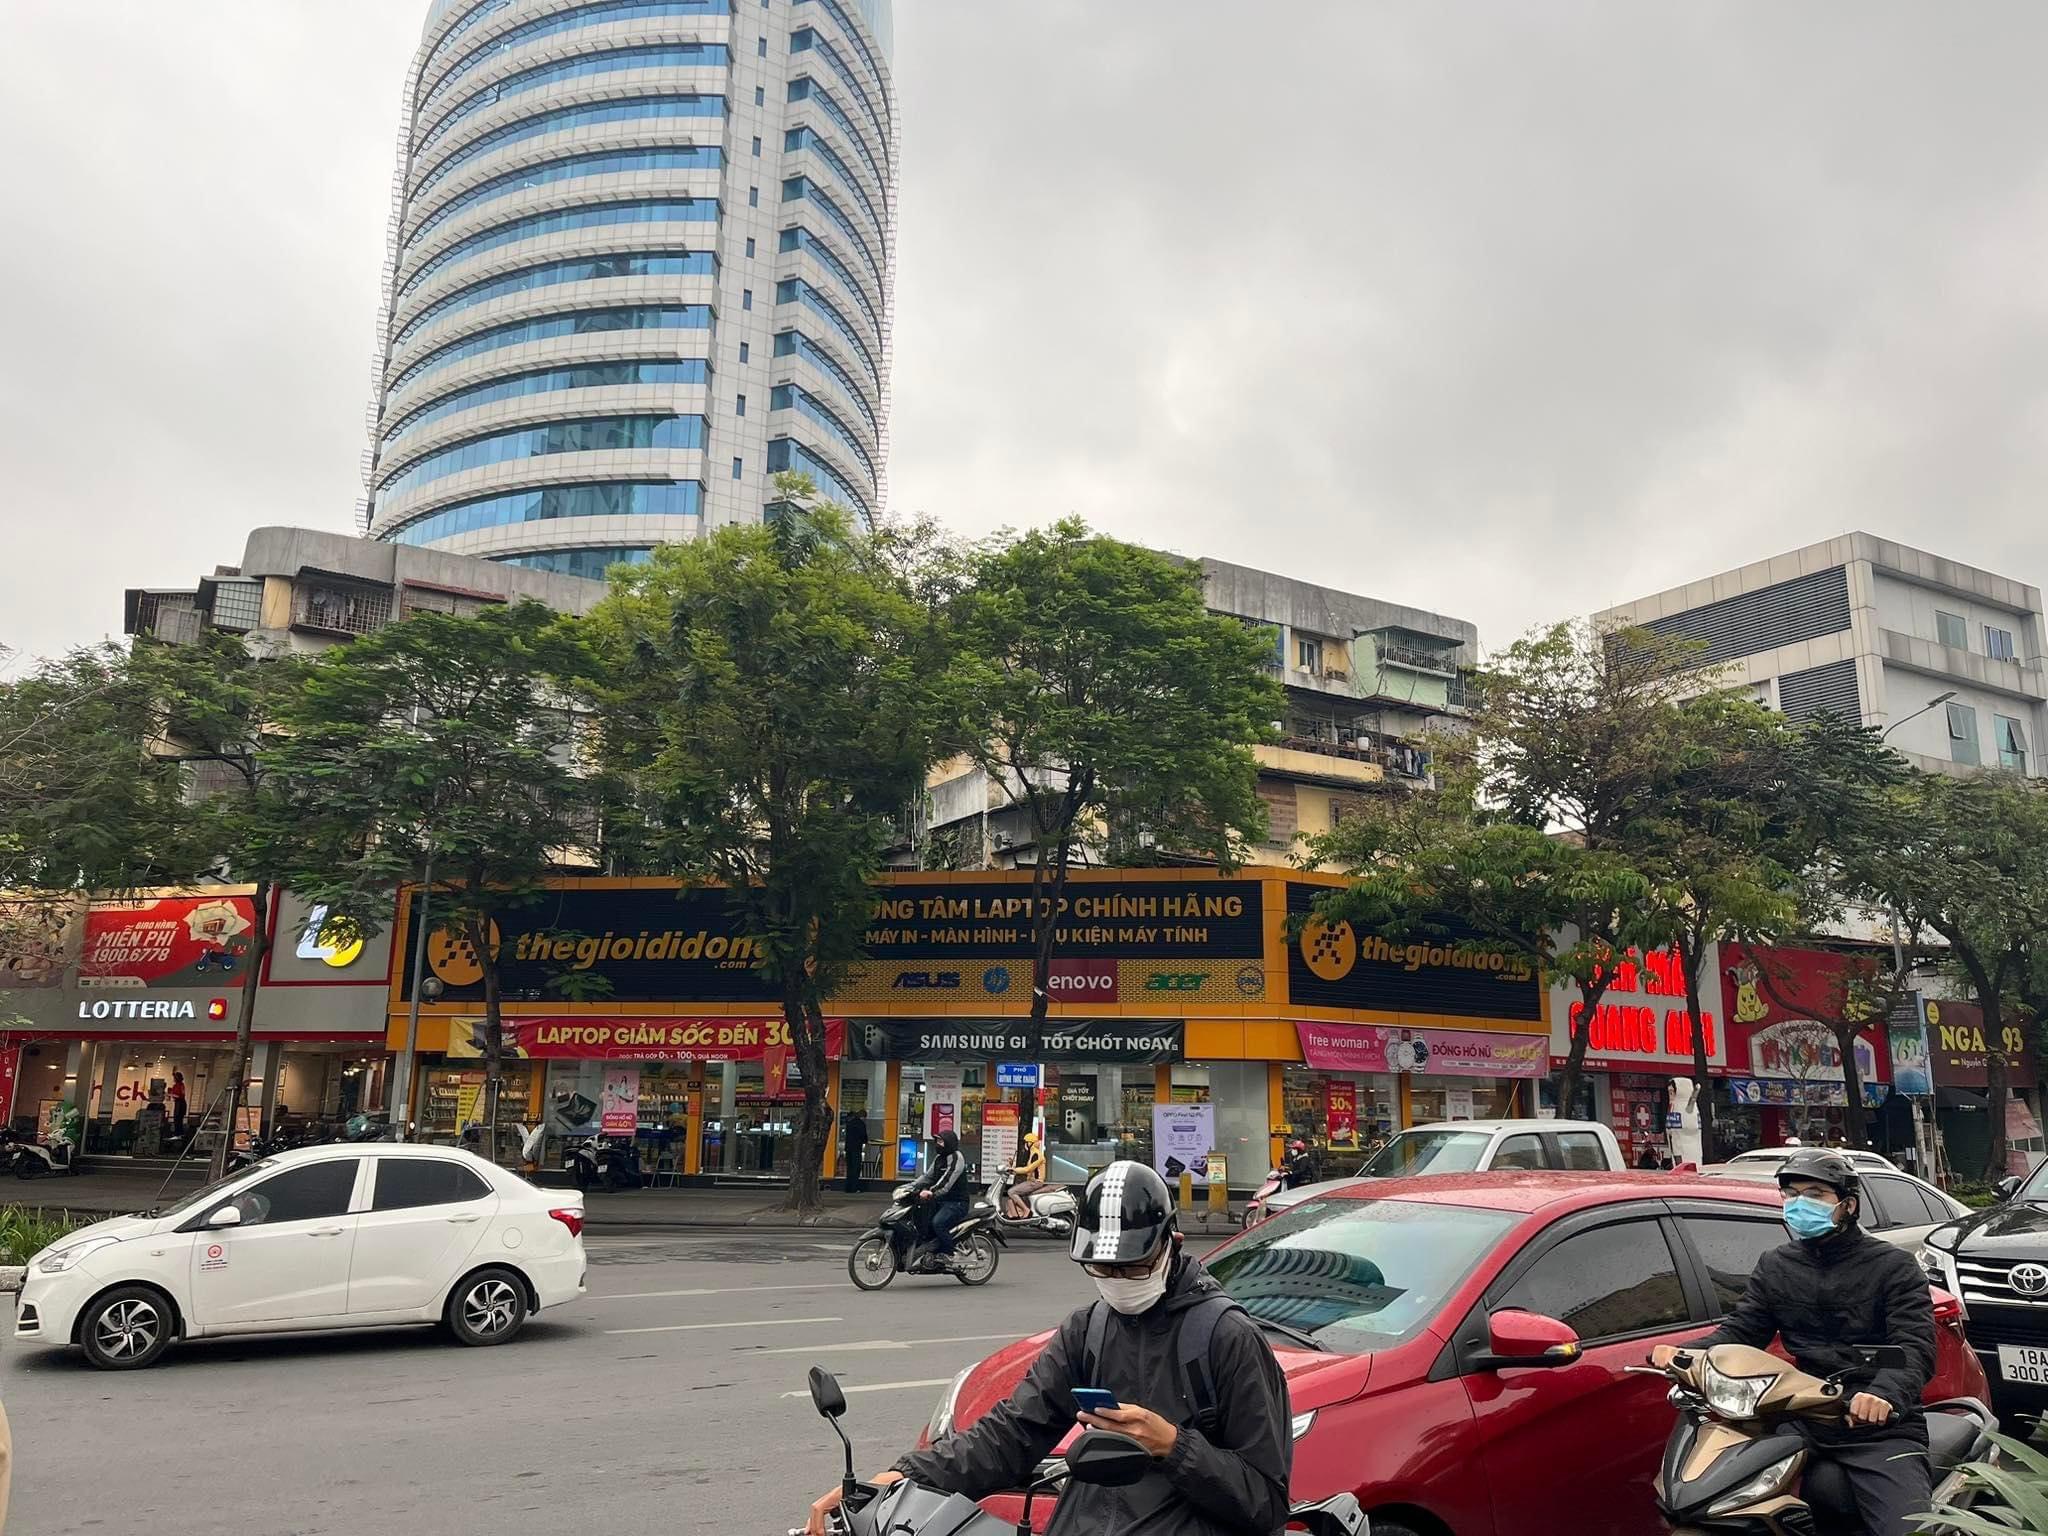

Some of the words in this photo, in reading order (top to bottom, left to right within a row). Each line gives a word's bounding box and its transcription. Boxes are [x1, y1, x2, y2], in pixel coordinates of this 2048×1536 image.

[919, 895, 968, 919] TÂM
[1074, 892, 1157, 918] CHÍNH
[1163, 892, 1243, 918] HÃNG
[96, 924, 143, 948] MIỄN
[144, 926, 180, 947] PHÍ
[865, 925, 899, 944] MÁY
[901, 928, 918, 943] IN
[930, 926, 969, 944] MÀN
[974, 926, 1017, 943] HÌNH
[1072, 926, 1114, 946] KIỆN
[1118, 925, 1157, 943] MÁY
[1163, 925, 1208, 943] TÍNH
[1047, 975, 1113, 990] enovo
[78, 1000, 196, 1019] LOTTERIA
[536, 1026, 611, 1045] LAPTOP
[614, 1022, 666, 1045] GIẢM
[669, 1021, 714, 1045] SỐC
[718, 1021, 758, 1045] ĐẾN
[920, 1034, 1006, 1049] SAMSUNG
[1009, 1035, 1027, 1049] GI
[1041, 1032, 1075, 1050] TỐT
[1076, 1033, 1122, 1050] CHỐT
[1308, 1033, 1329, 1047] free
[1331, 1037, 1370, 1049] woman
